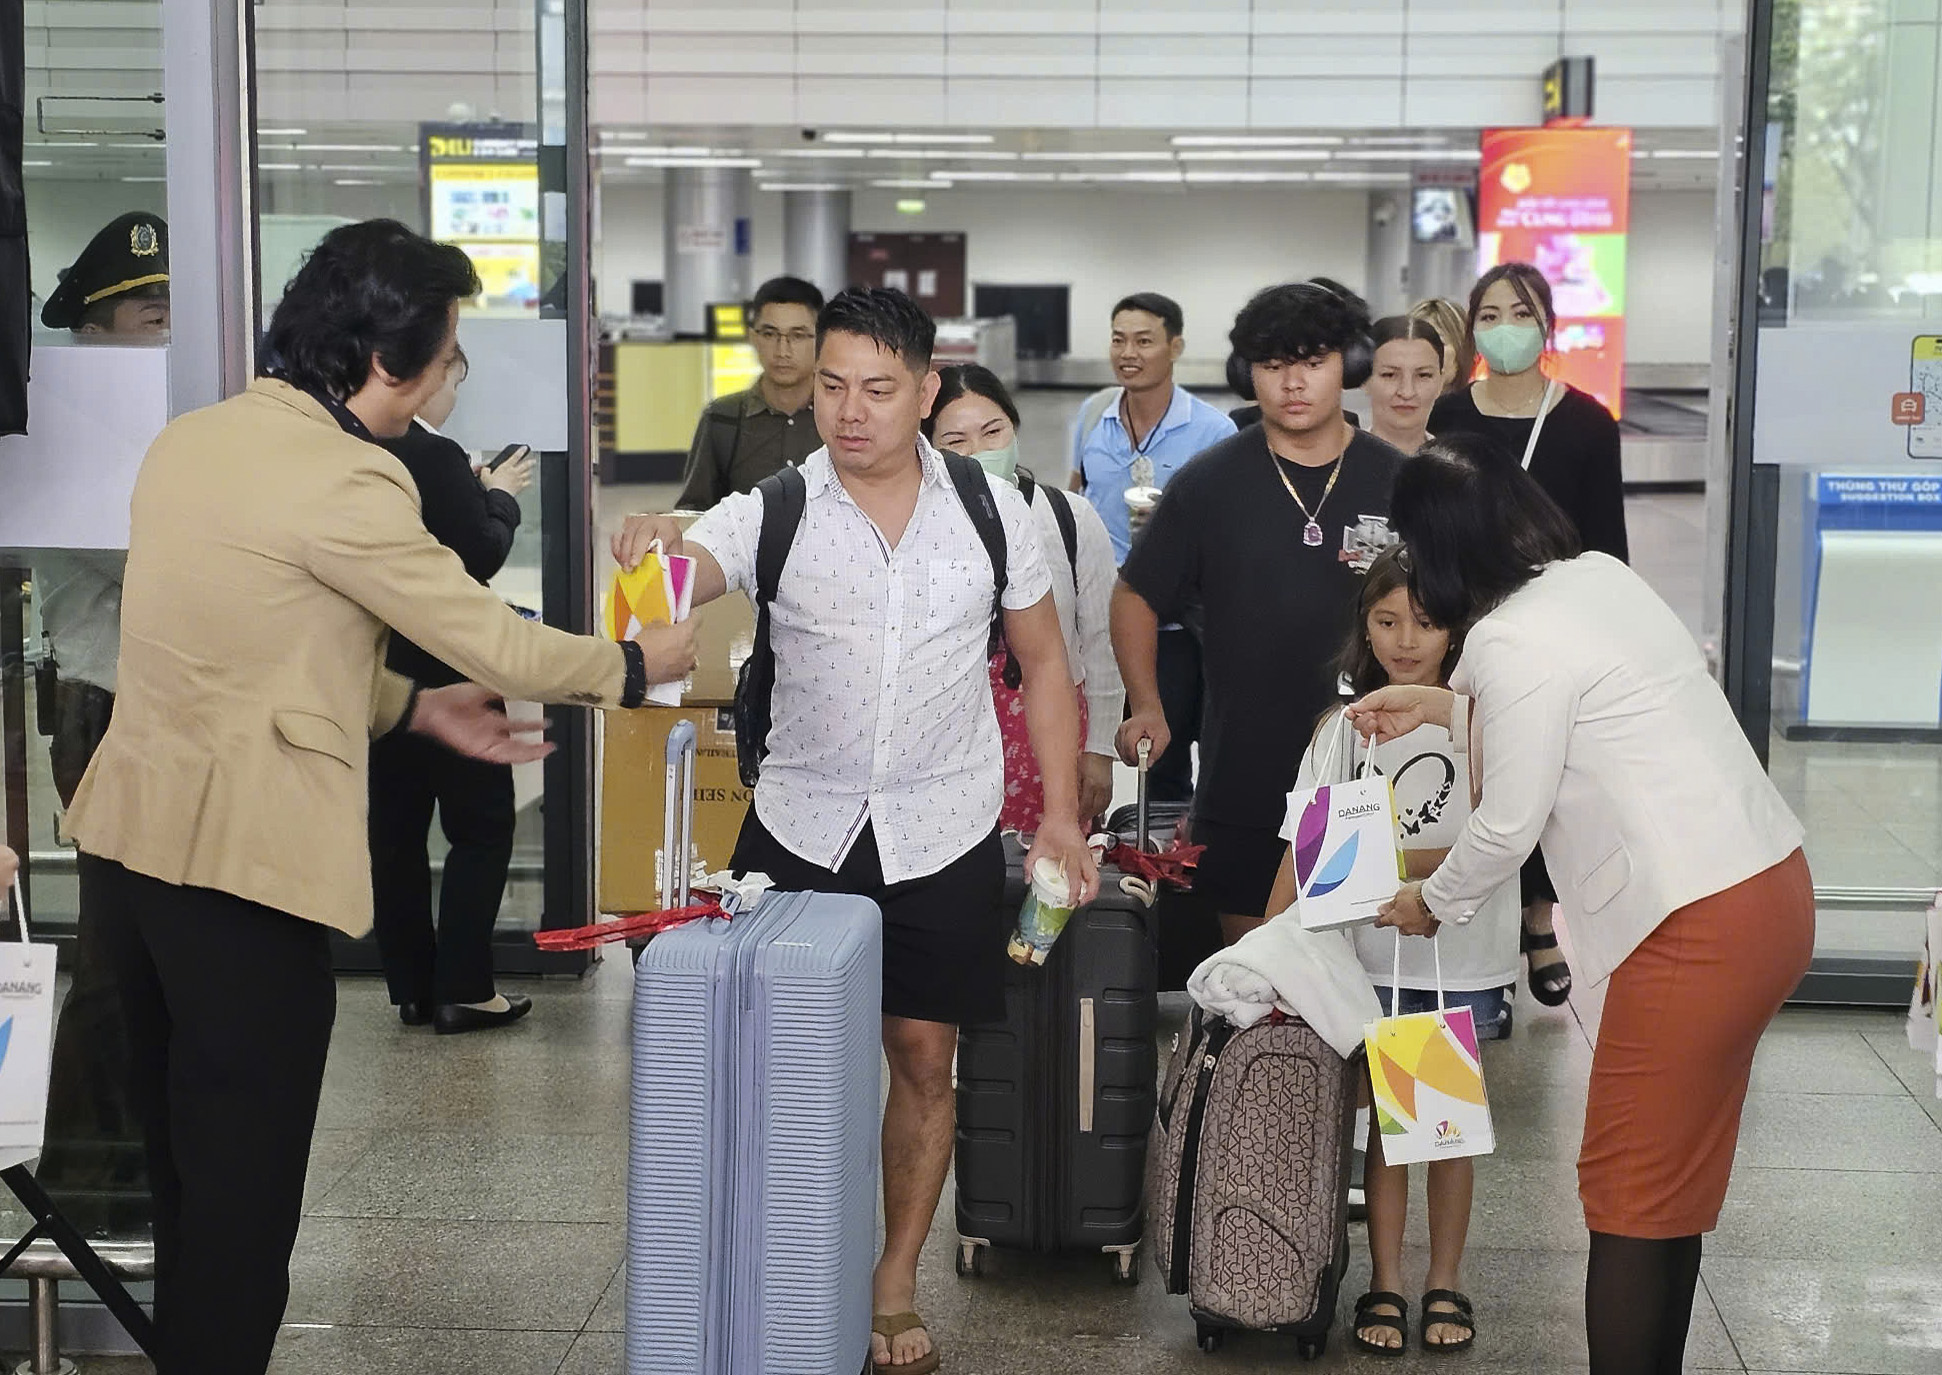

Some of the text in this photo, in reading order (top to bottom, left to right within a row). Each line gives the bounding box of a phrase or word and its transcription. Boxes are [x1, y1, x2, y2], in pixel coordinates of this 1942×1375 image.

[1911, 479, 1940, 491] GÓP
[1338, 803, 1380, 818] DANANG
[0, 981, 42, 995] ANANG
